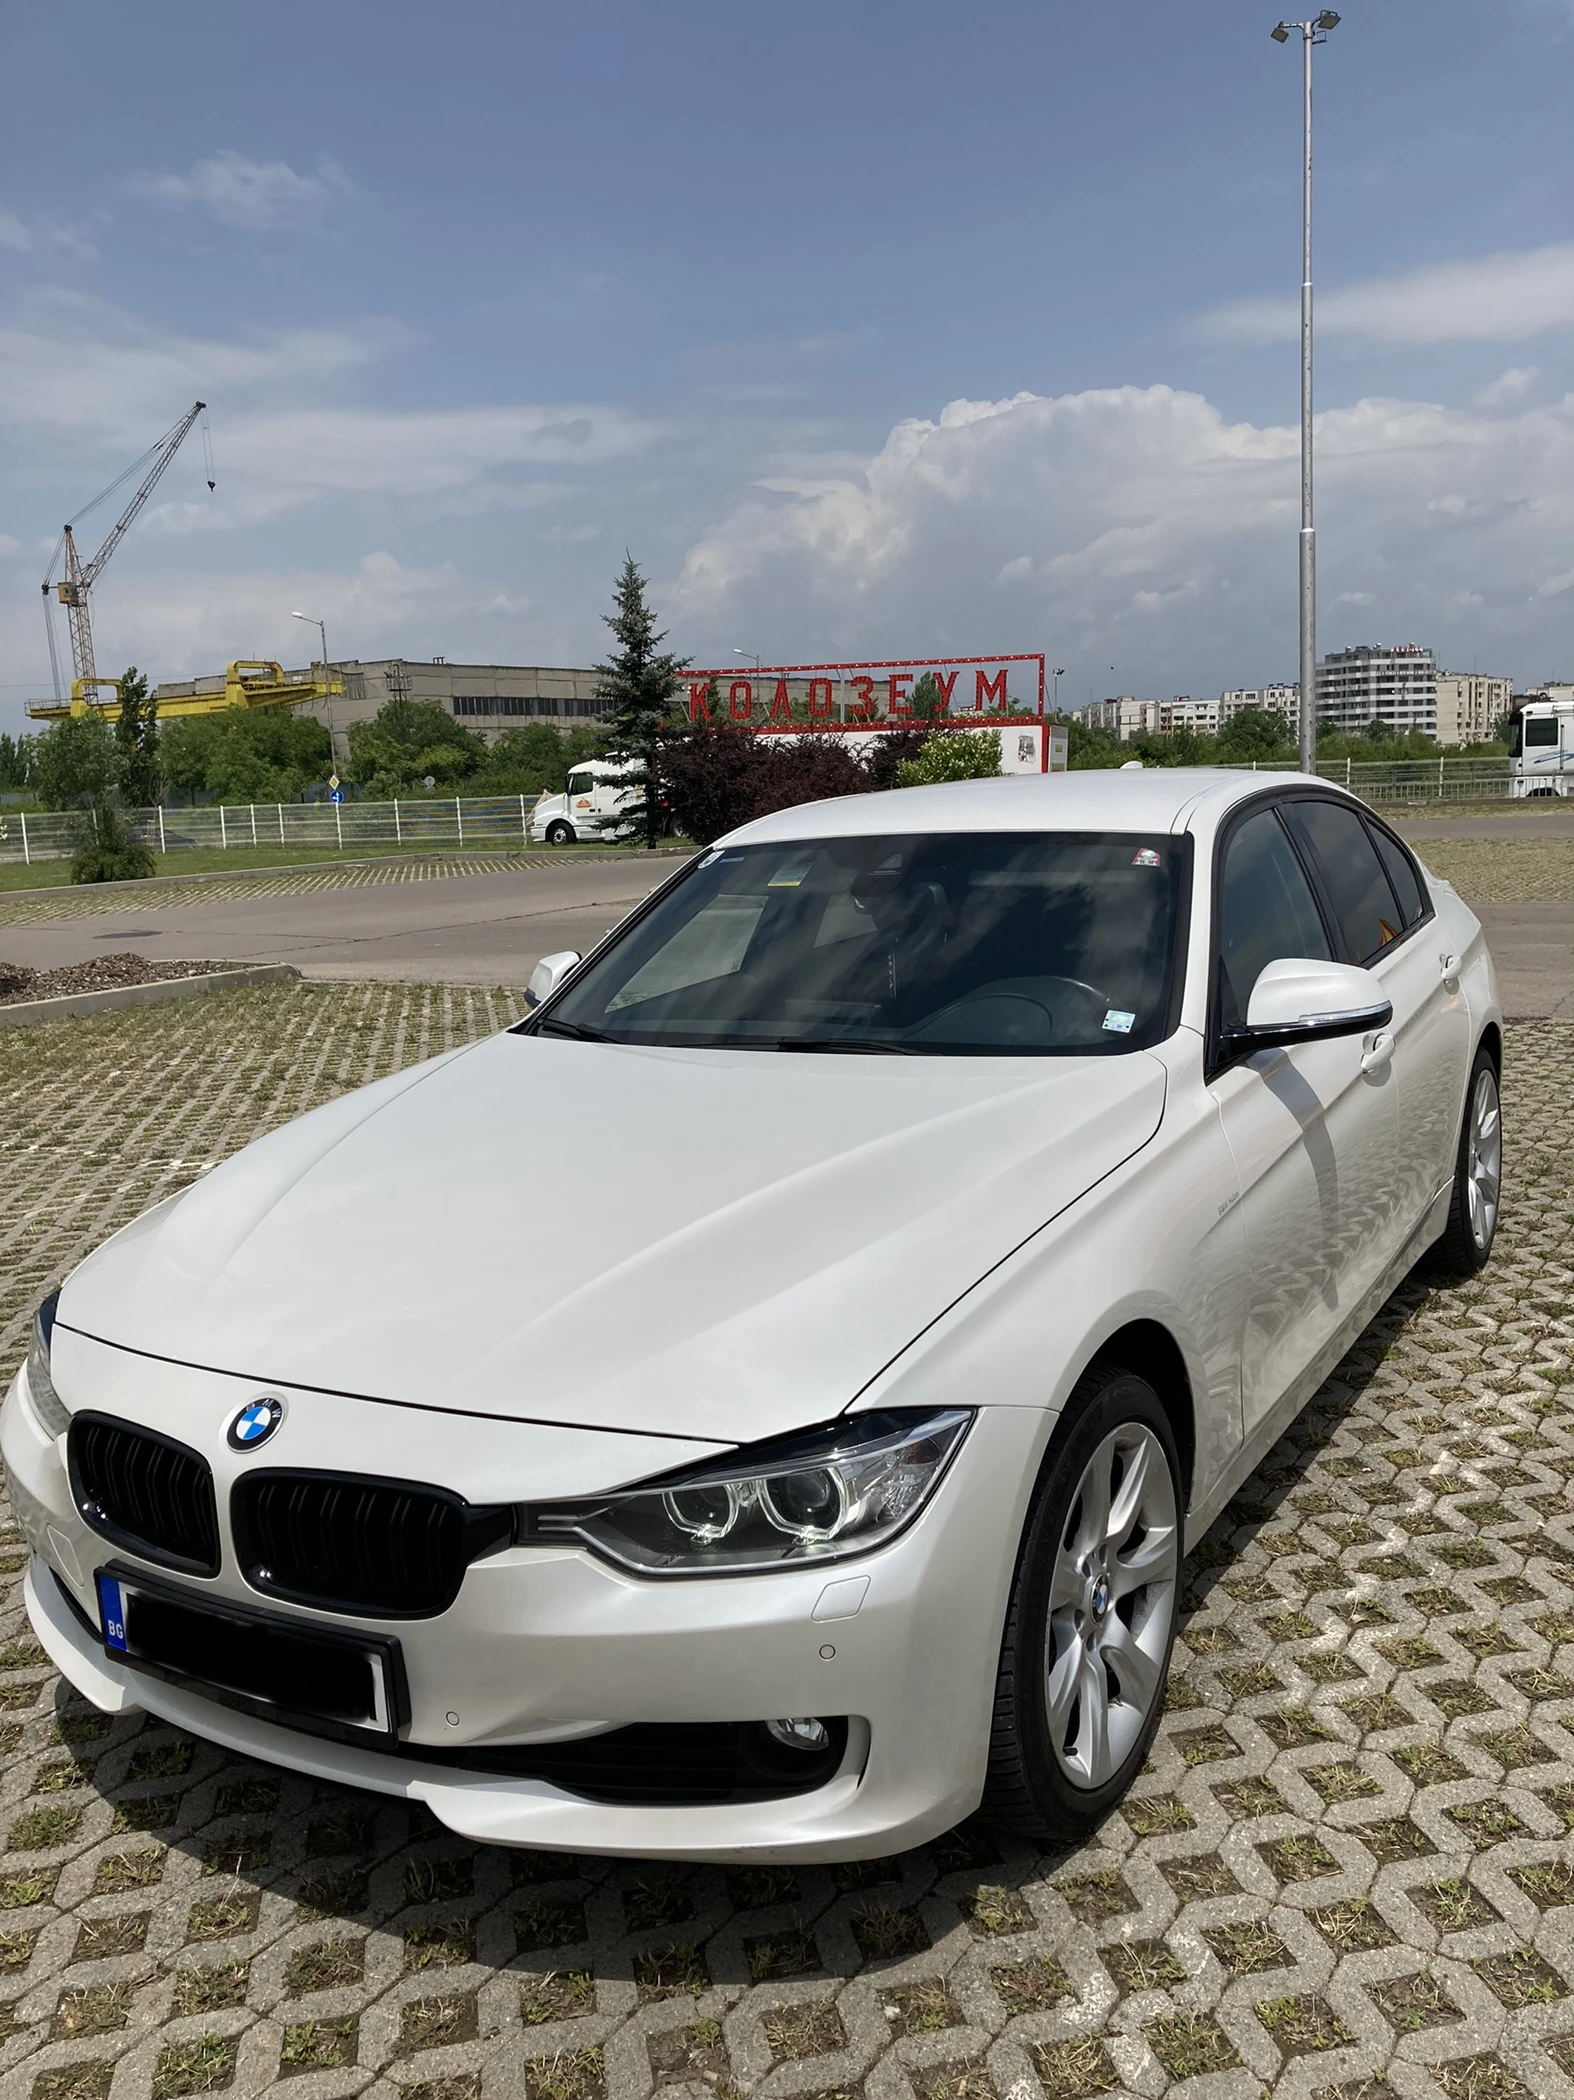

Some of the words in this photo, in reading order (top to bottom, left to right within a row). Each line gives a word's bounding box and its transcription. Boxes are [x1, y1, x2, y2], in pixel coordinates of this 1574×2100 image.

[690, 669, 1008, 721] КОЛОЗЕУМ
[245, 1398, 282, 1418] BMW
[107, 1619, 124, 1640] BG
